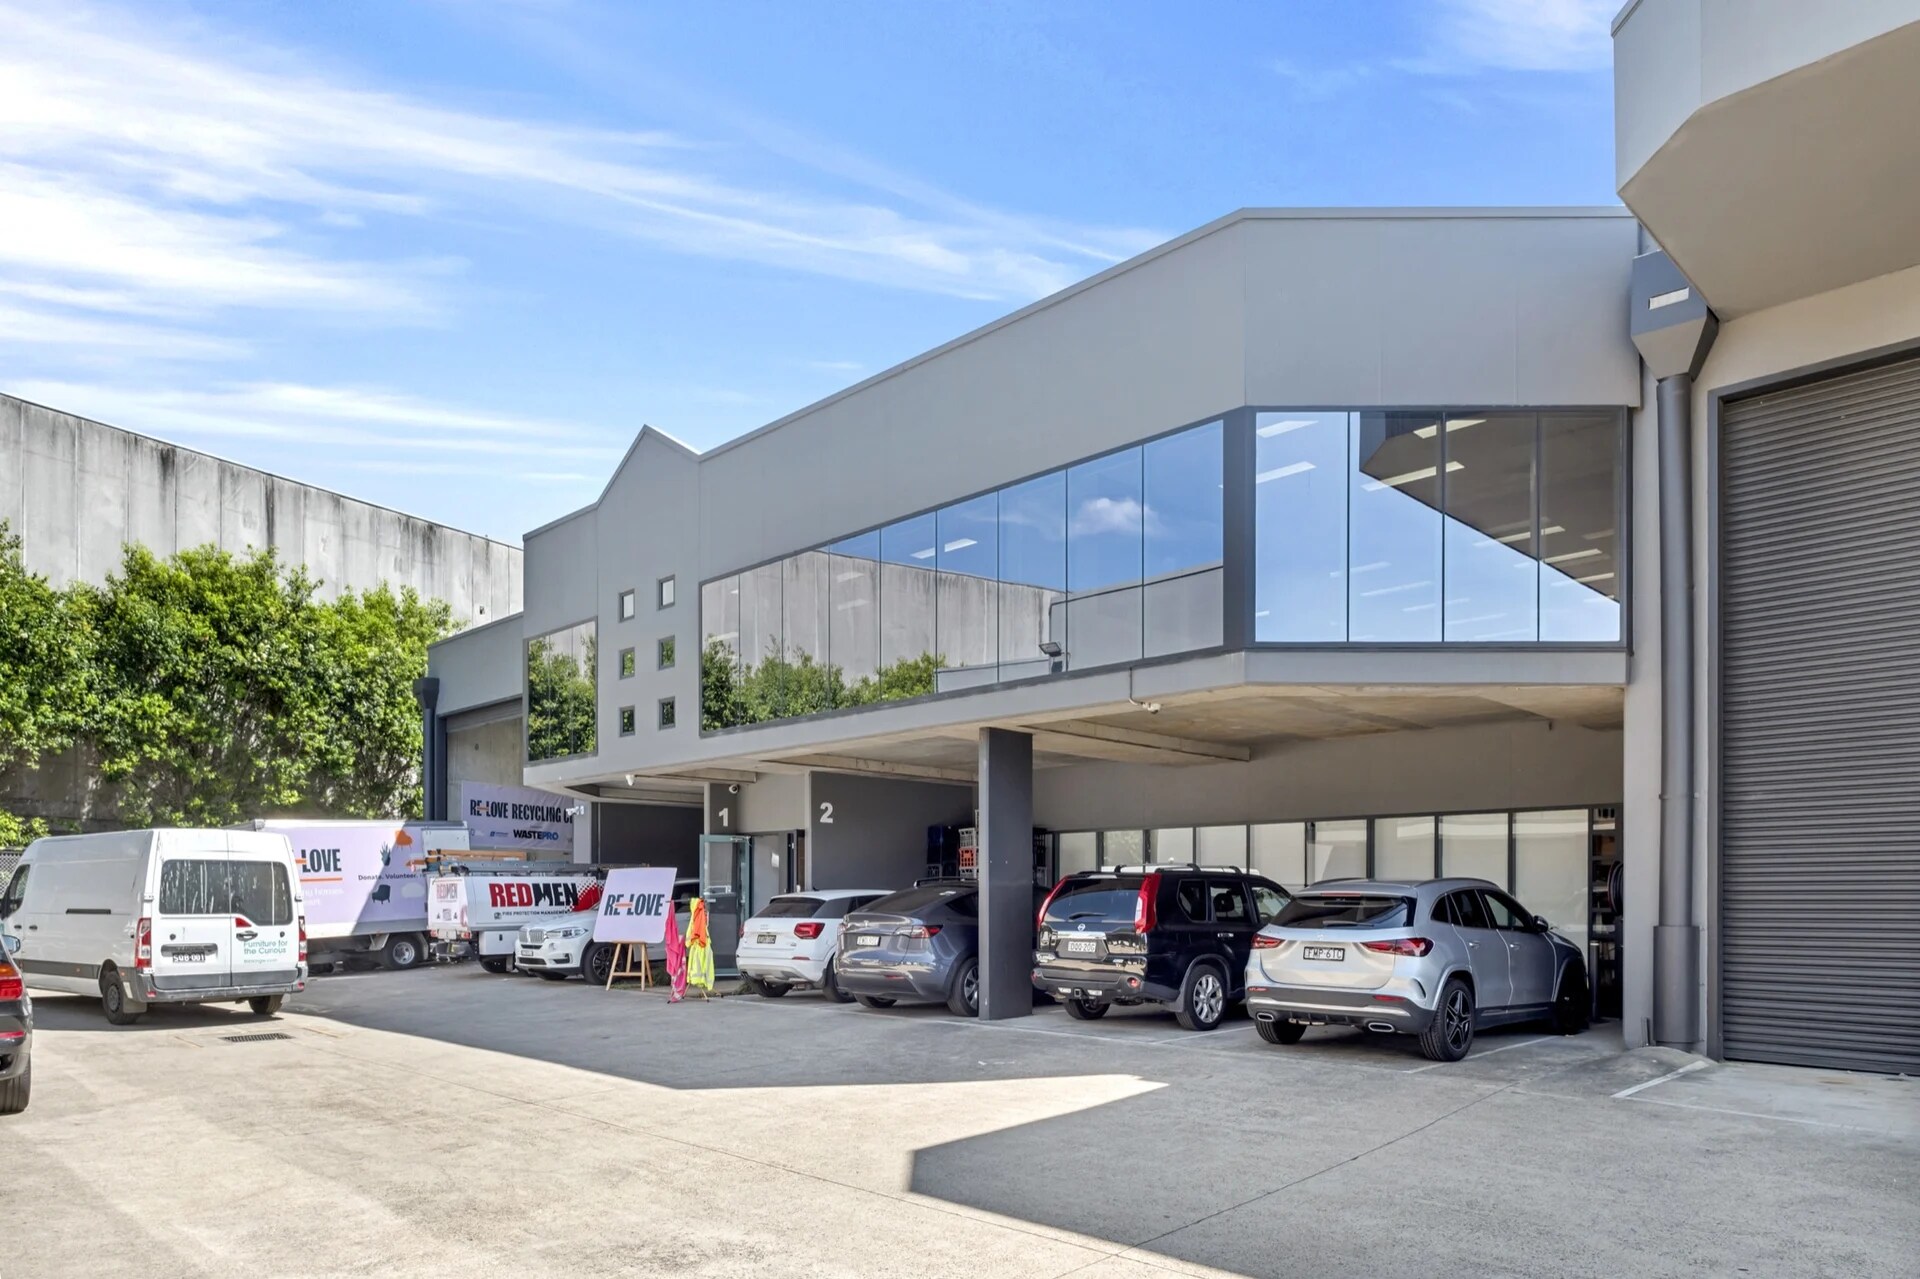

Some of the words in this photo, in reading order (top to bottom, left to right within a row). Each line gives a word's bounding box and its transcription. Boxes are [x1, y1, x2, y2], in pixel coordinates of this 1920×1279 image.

[511, 803, 562, 823] RECYCLING
[718, 808, 728, 826] 1
[820, 802, 833, 823] 2
[513, 829, 559, 840] WASTEPRO
[488, 882, 578, 908] REDMEN
[258, 947, 287, 955] Curious
